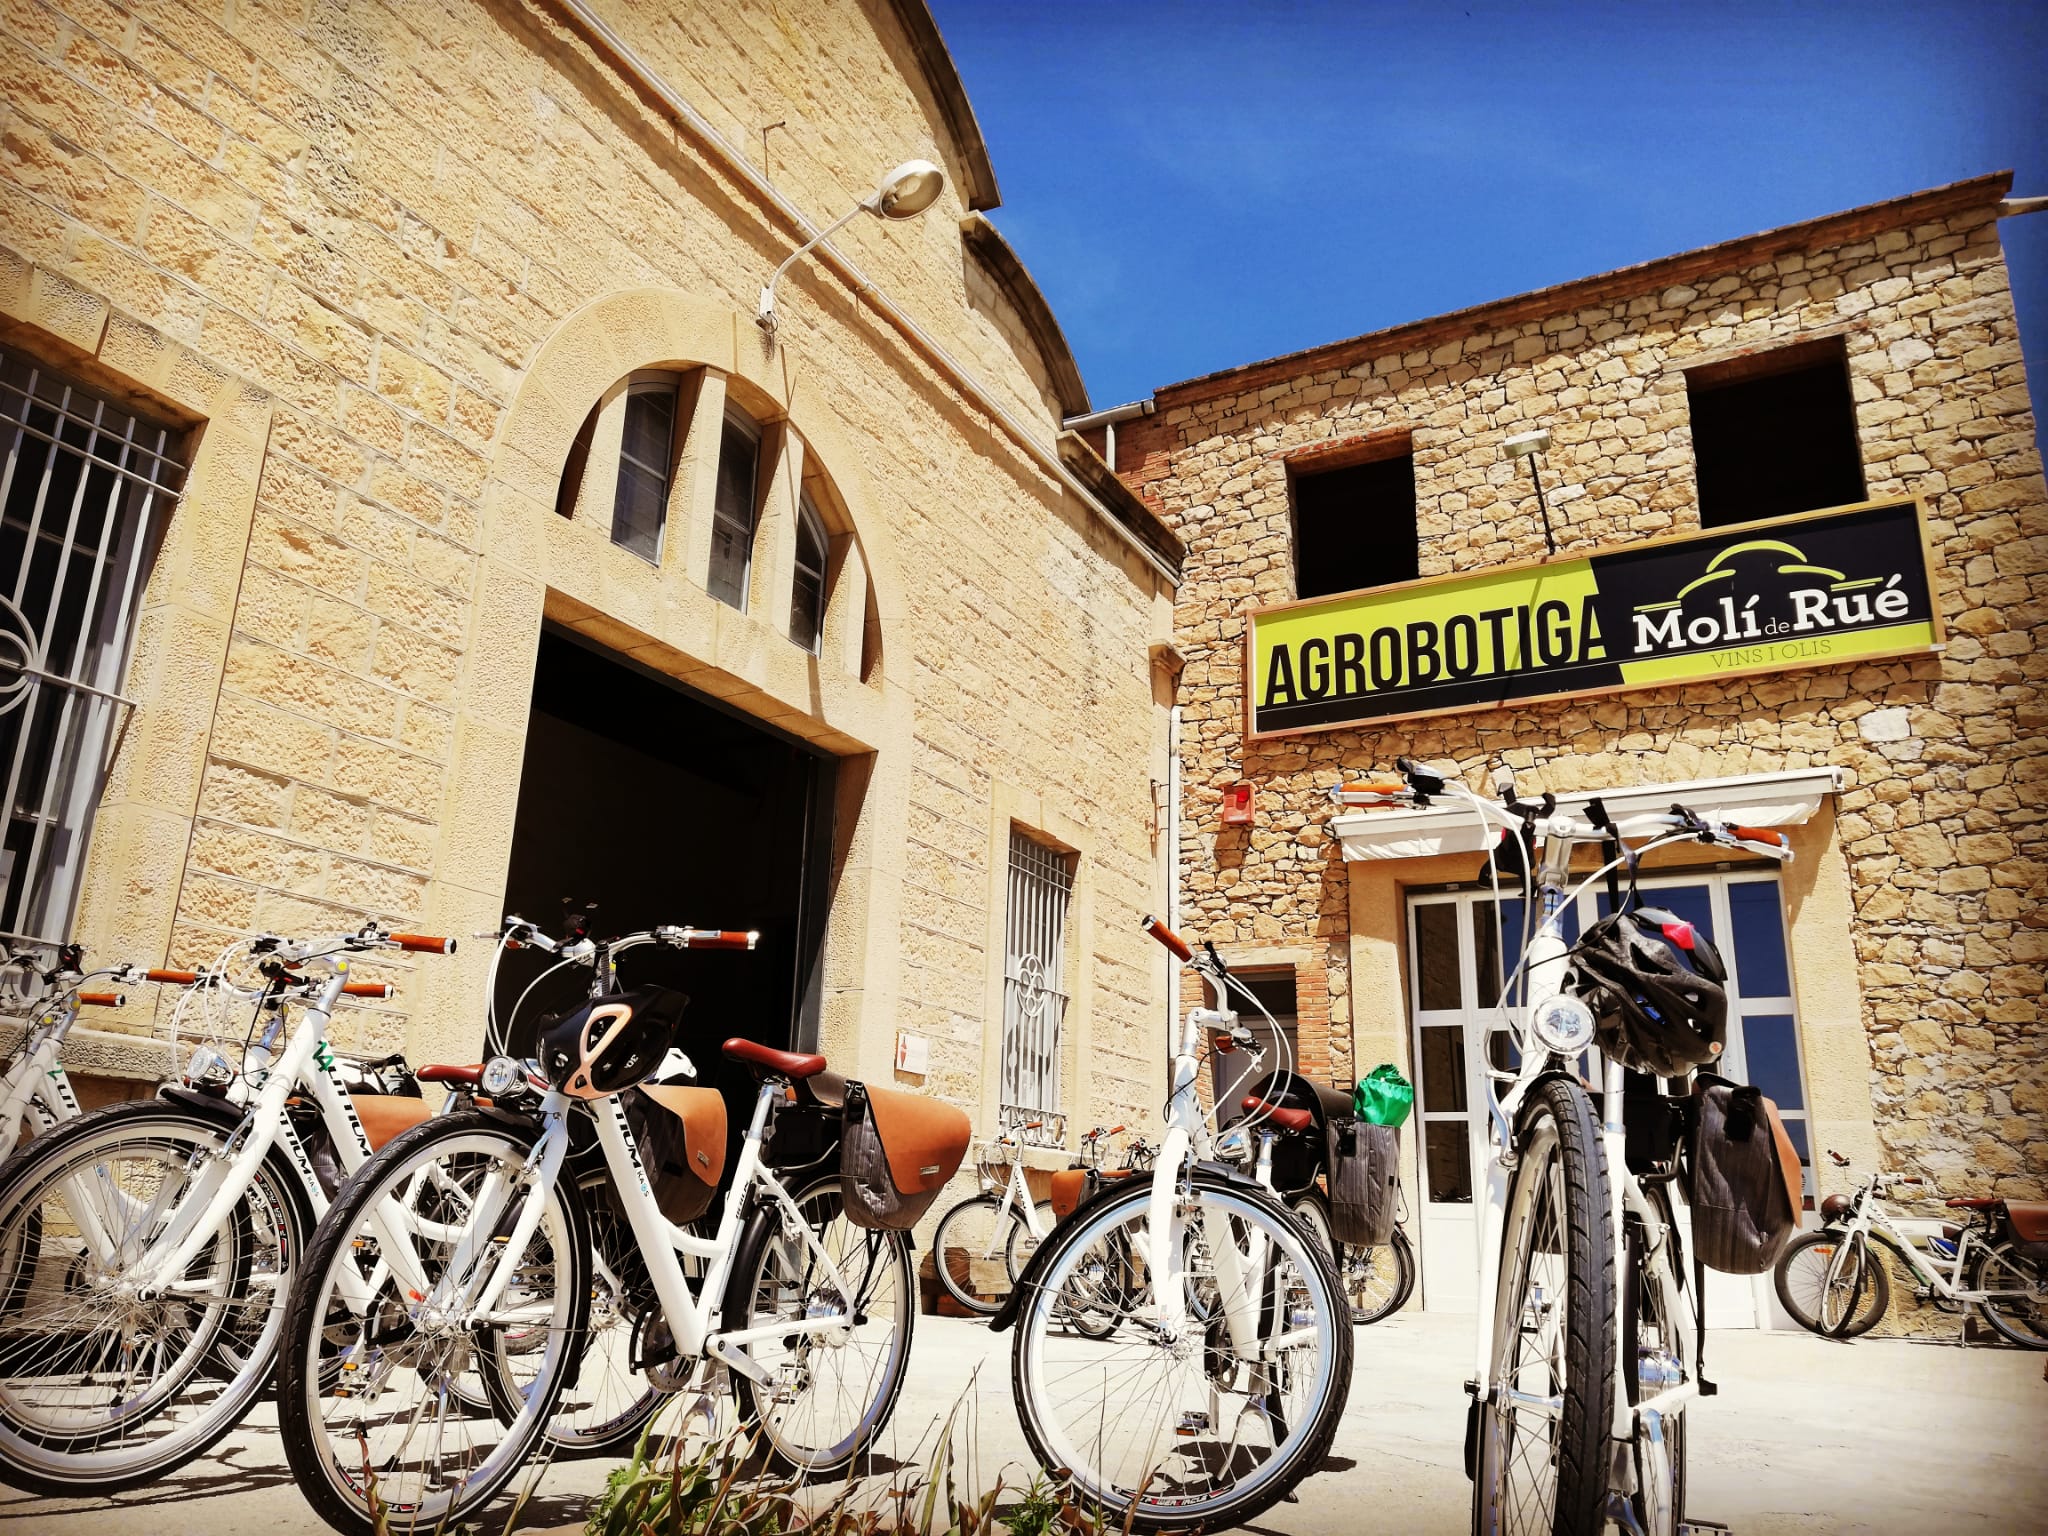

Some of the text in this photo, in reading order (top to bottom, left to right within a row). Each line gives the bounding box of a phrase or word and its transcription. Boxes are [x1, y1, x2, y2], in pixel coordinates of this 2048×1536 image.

[1264, 592, 1607, 707] AGROBOTIGA
[1632, 573, 1909, 654] Molí de Rué
[1710, 639, 1833, 669] VINS I OLIS
